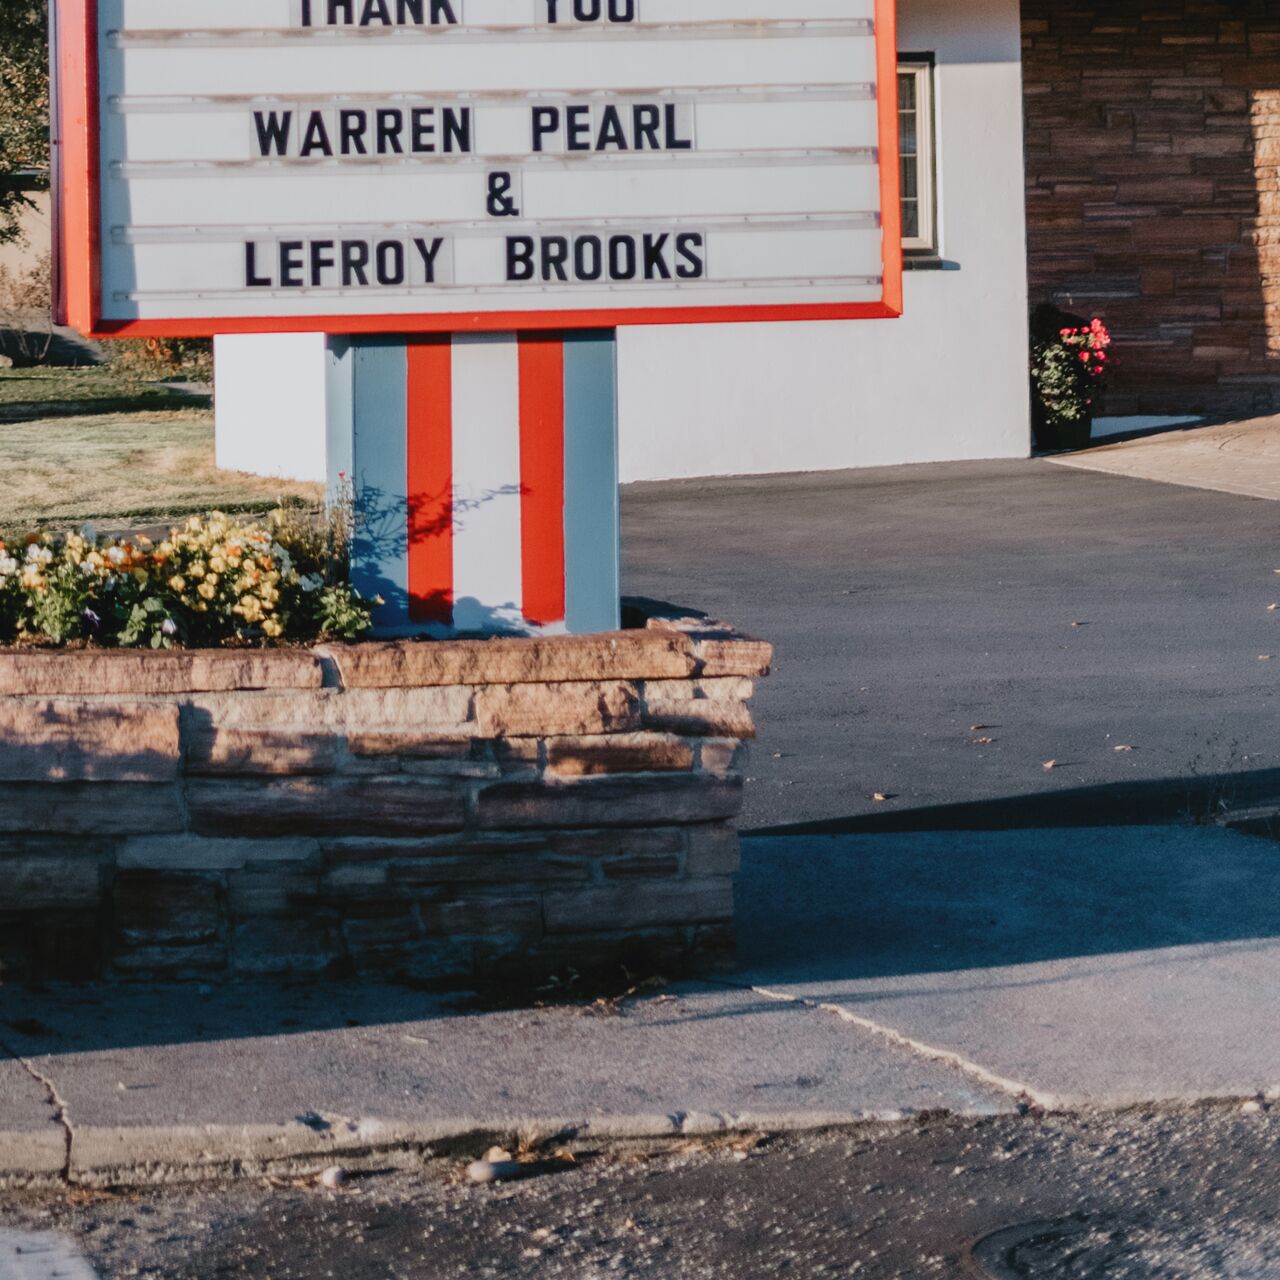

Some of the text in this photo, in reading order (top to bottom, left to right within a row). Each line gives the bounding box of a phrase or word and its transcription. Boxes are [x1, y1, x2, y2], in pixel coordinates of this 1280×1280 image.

[252, 102, 692, 157] WARREN PEARL
[486, 170, 520, 217] &
[245, 231, 705, 288] LEFROY BROOKS
